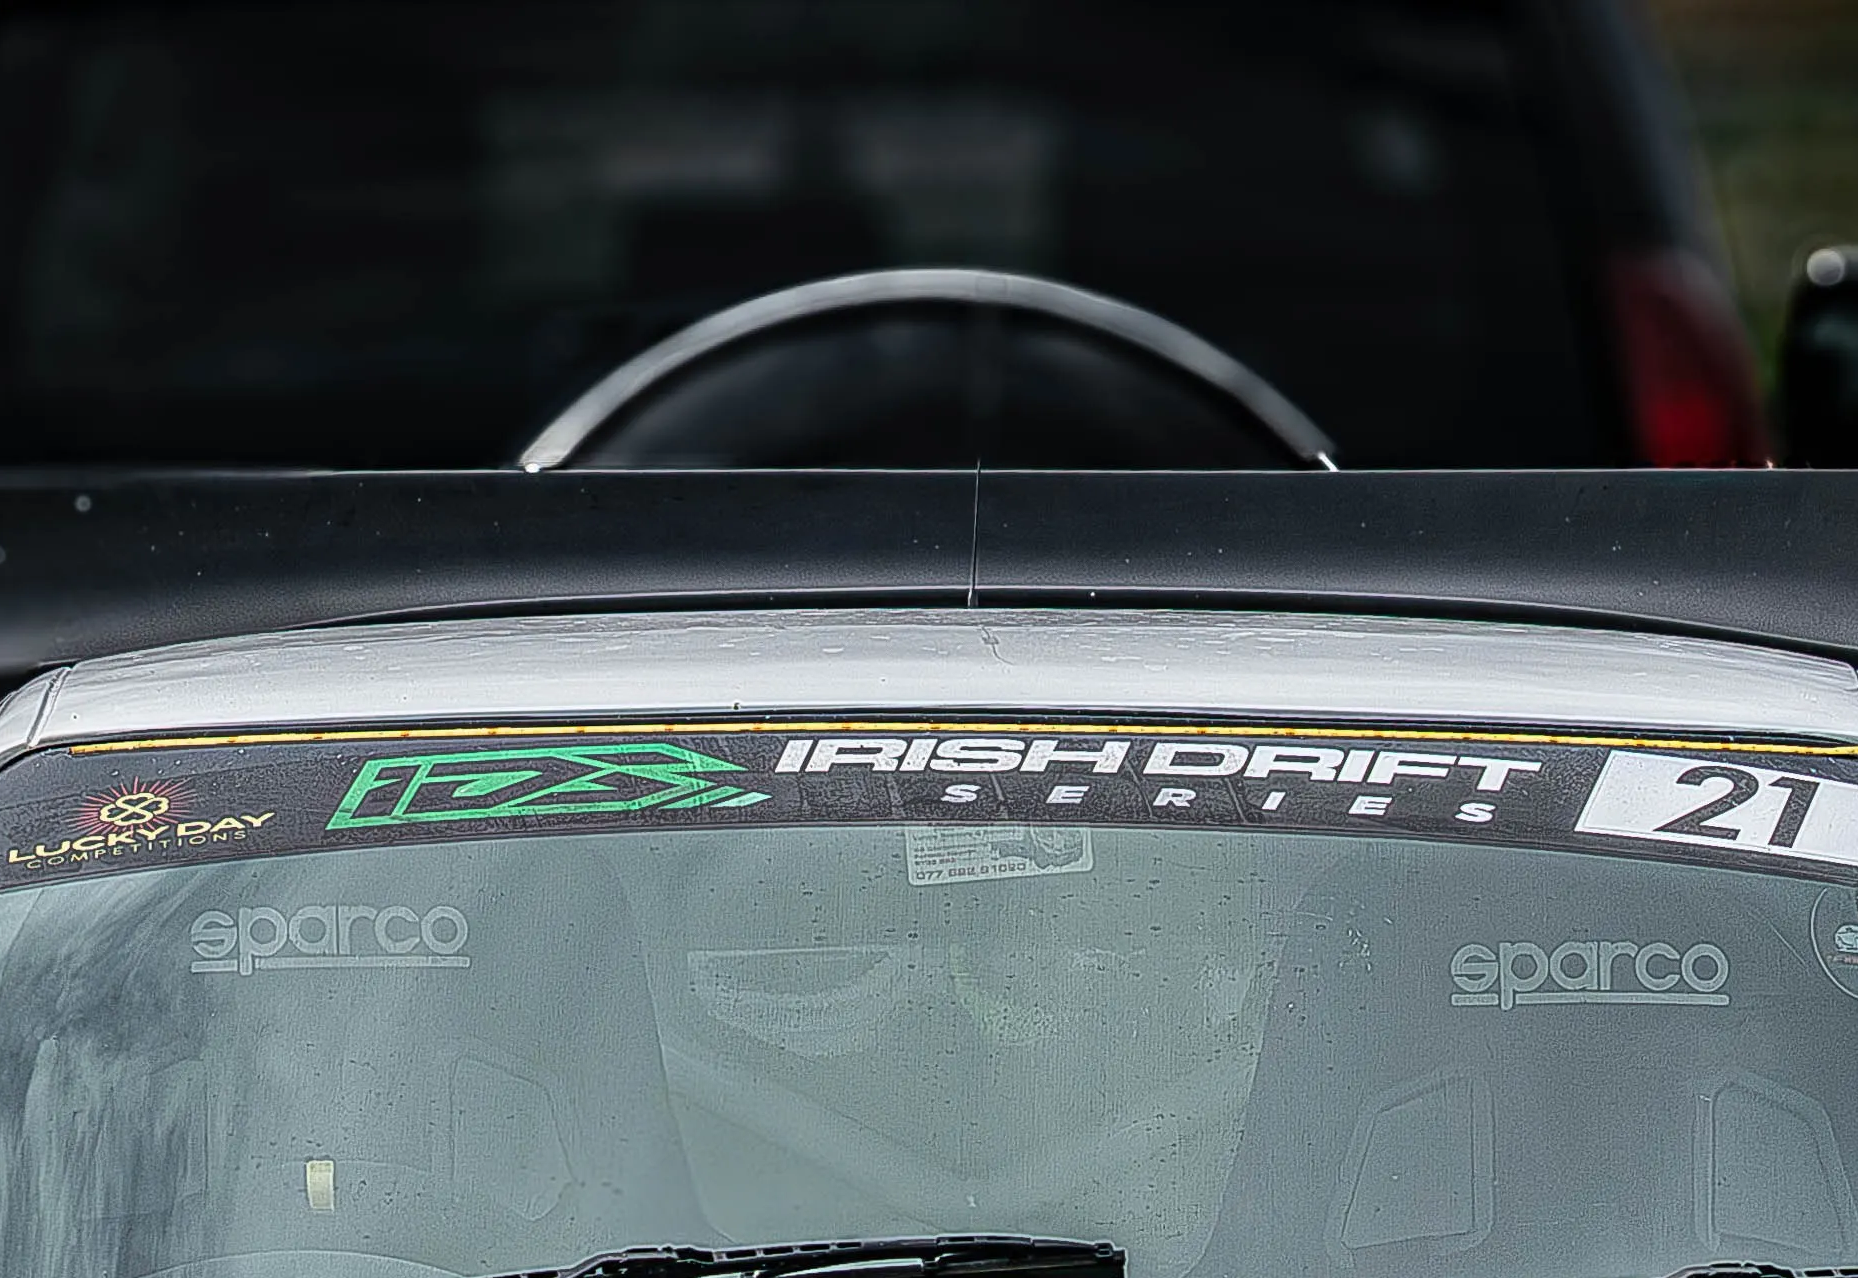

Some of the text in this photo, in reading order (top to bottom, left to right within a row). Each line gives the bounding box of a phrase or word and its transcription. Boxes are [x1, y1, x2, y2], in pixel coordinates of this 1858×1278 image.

[775, 738, 1543, 792] IRISH DRIFT
[940, 784, 1498, 823] SERIES
[1652, 765, 1821, 849] 21
[8, 812, 276, 863] LUCKY DAY
[26, 830, 247, 869] COMPETITIONS
[191, 904, 470, 976] sparco
[1450, 941, 1730, 1011] sparco
